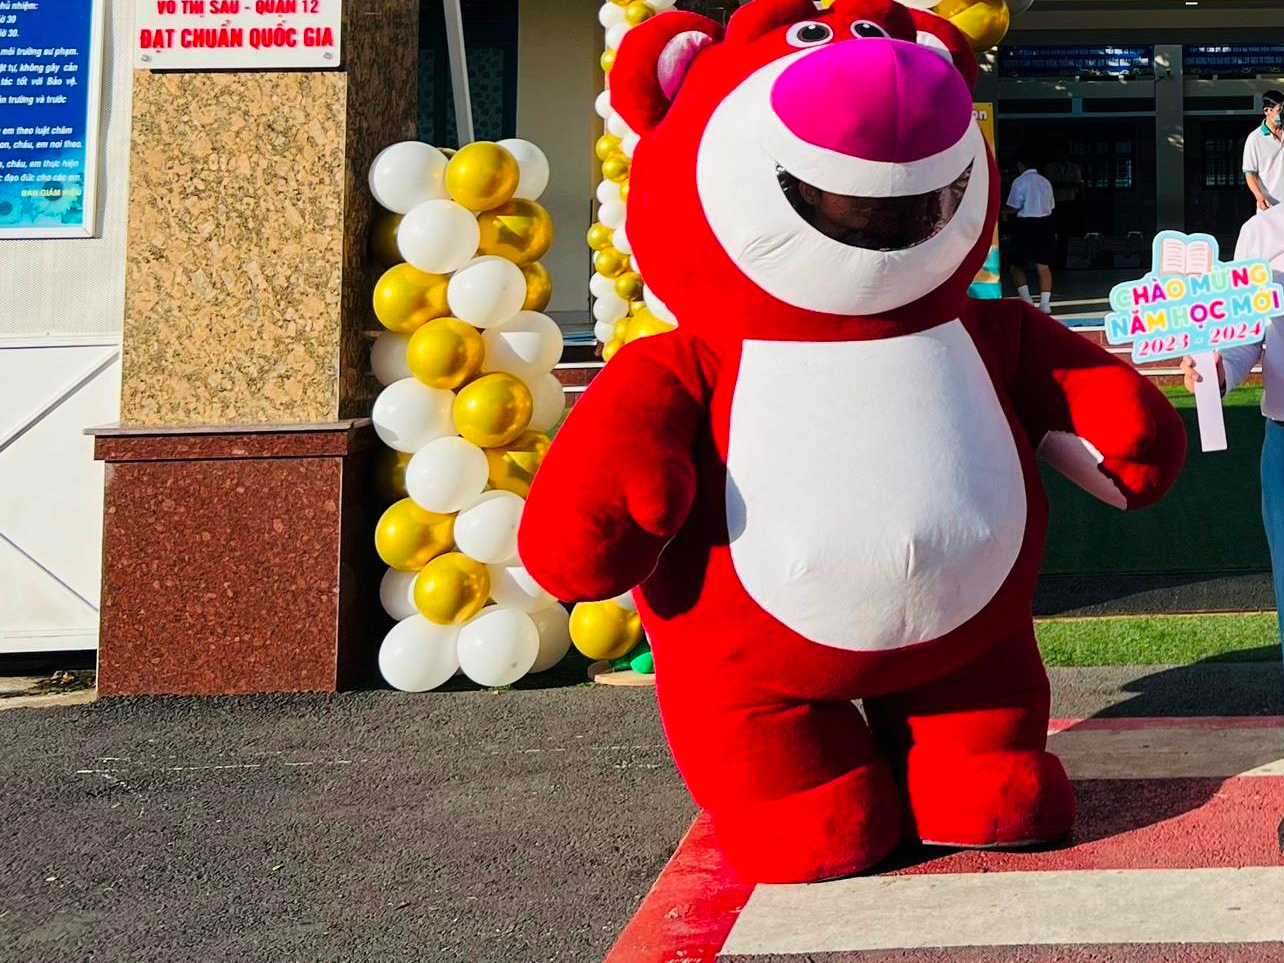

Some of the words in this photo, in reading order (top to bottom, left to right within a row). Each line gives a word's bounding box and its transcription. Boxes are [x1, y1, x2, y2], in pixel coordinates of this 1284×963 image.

[6, 15, 17, 23] 30
[181, 0, 204, 17] THỊ
[302, 0, 319, 14] 12
[7, 29, 20, 37] 30.
[140, 28, 175, 53] ĐẠT
[181, 20, 243, 48] CHUẨN
[249, 20, 297, 50] QUỐC
[303, 27, 333, 47] GIA
[1115, 278, 1185, 308] CHÀO
[1190, 263, 1268, 295] MỪNG
[1110, 309, 1167, 337] NĂM
[1171, 300, 1226, 329] HỌC
[1231, 285, 1280, 318] MỚI
[1138, 333, 1190, 356] 2023
[1210, 321, 1262, 343] 2024
